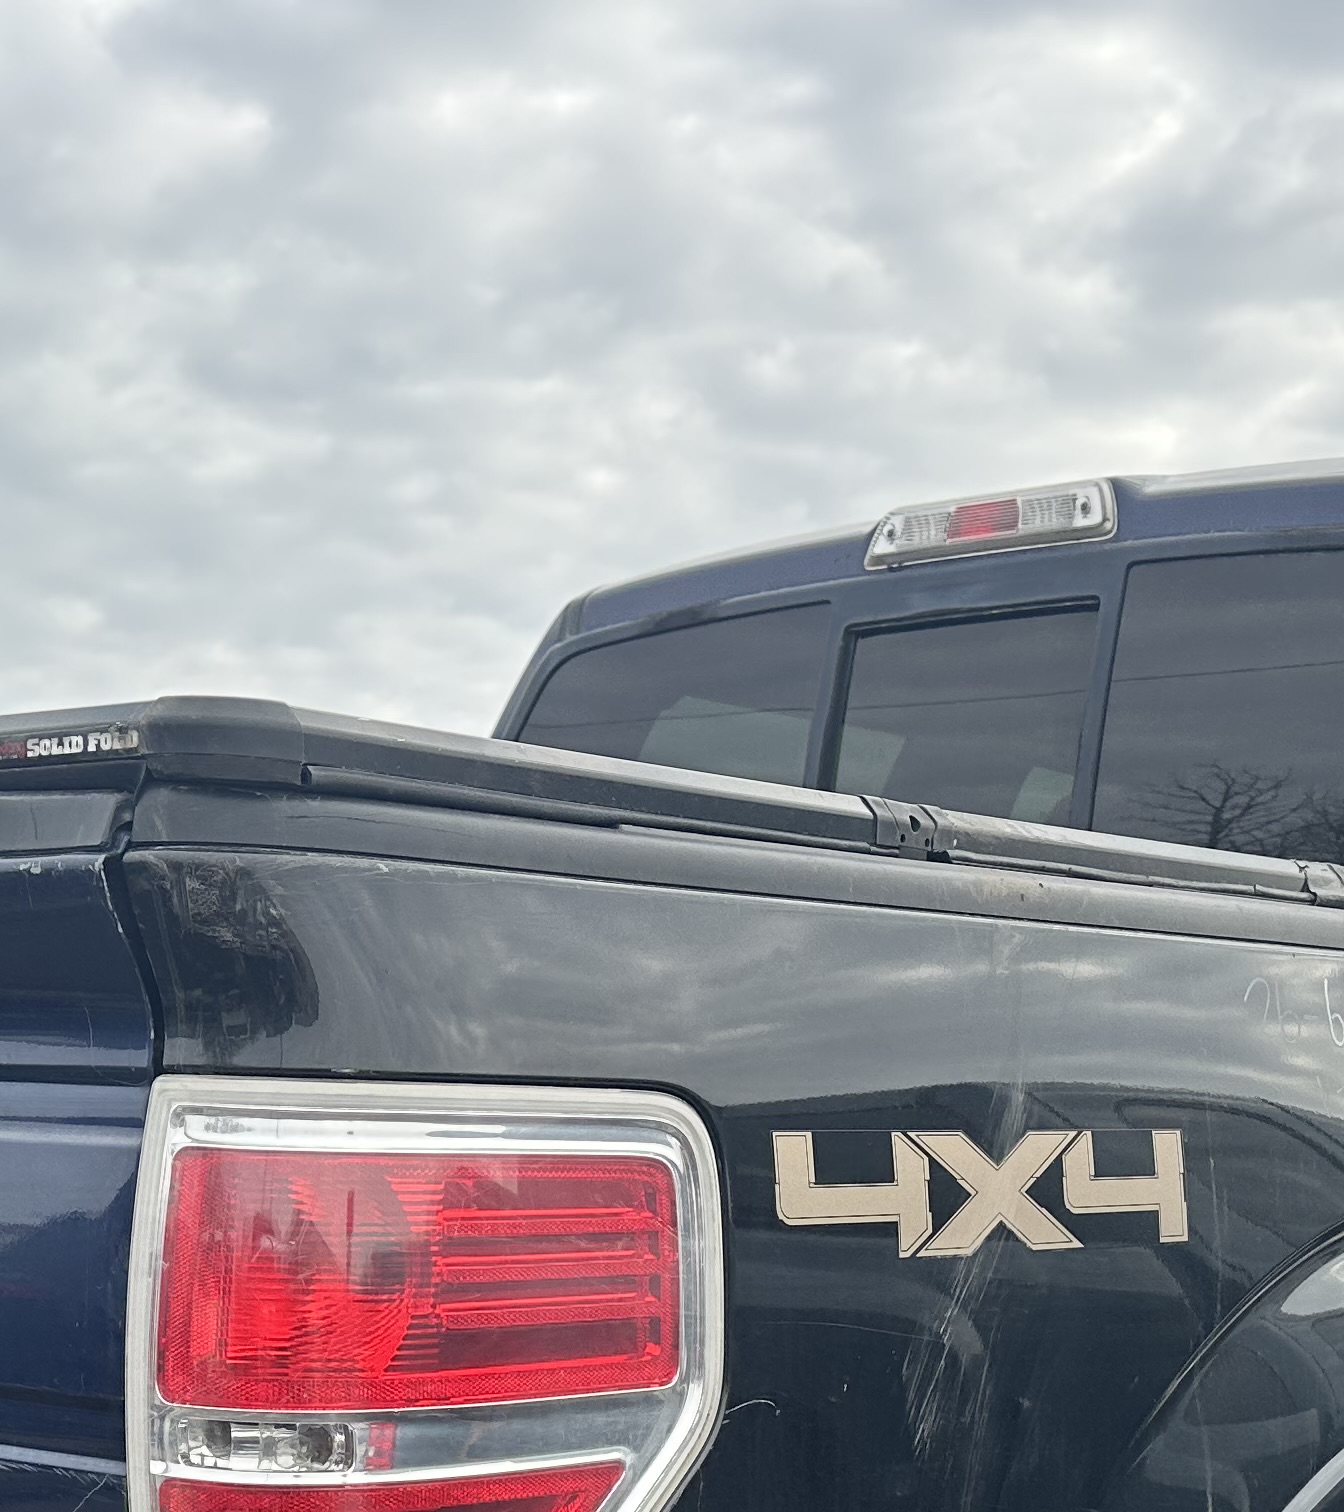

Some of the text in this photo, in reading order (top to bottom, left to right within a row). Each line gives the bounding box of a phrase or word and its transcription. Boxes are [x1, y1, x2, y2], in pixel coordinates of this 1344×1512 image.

[27, 735, 84, 757] SOLID
[87, 730, 139, 752] FOLD
[770, 1130, 1189, 1258] 4X4
